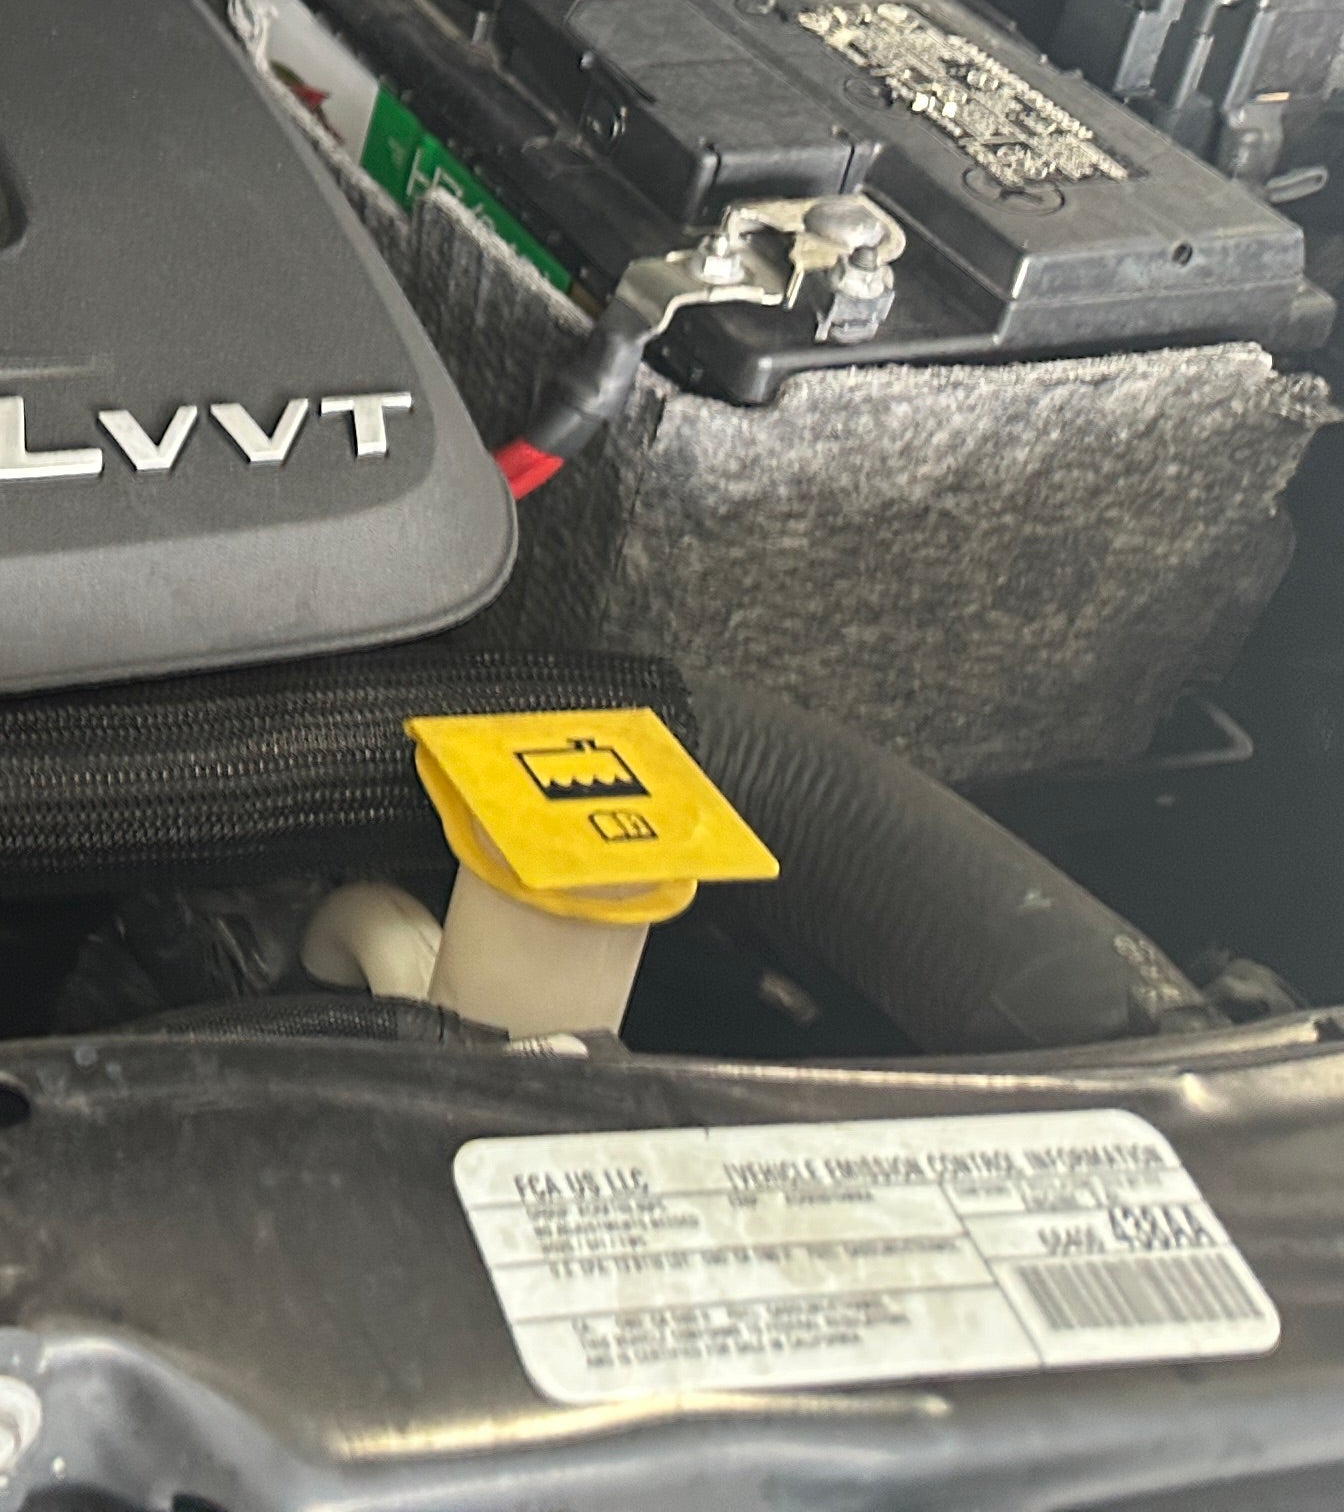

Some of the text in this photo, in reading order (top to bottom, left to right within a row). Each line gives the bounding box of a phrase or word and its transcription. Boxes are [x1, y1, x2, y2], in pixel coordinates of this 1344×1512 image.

[513, 1171, 561, 1203] FCA
[564, 1169, 601, 1199] US
[729, 1143, 1165, 1191] VEHICLE EMISSION CONTROL INFORMATION
